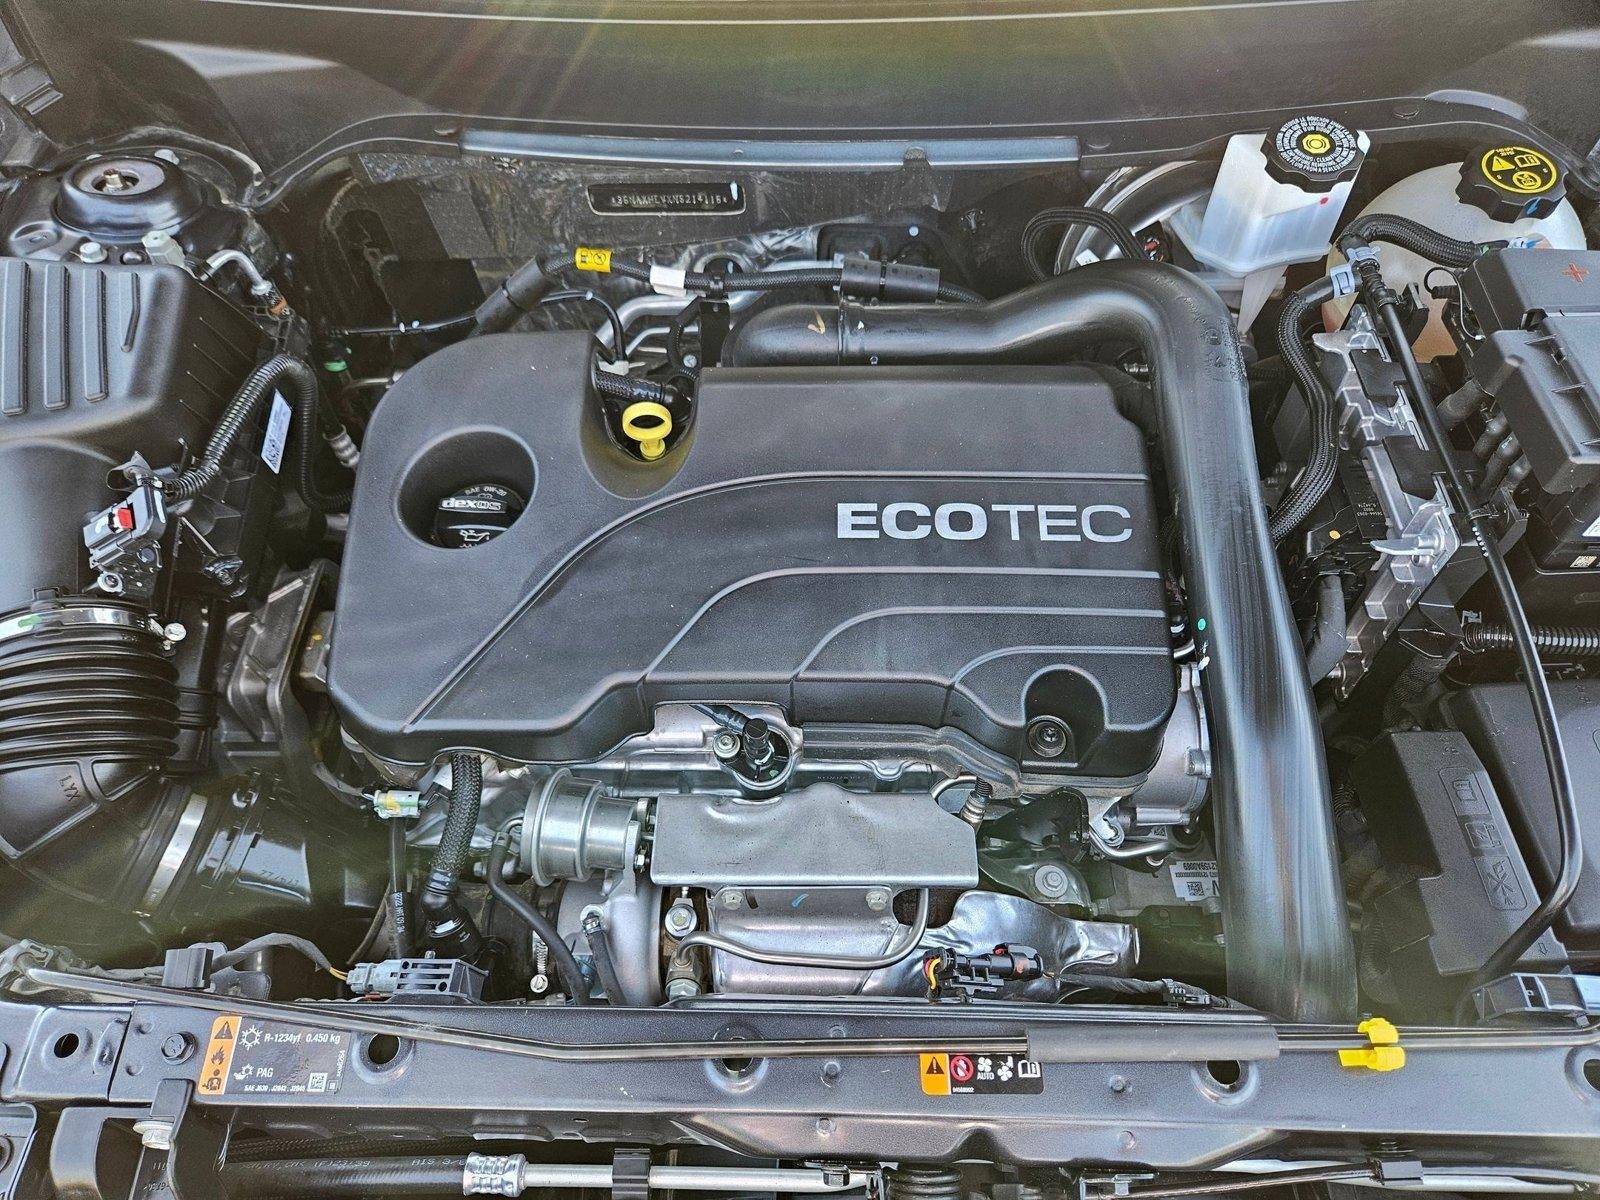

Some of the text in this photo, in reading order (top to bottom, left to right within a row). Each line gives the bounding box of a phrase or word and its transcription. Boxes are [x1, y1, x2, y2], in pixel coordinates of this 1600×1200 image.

[441, 497, 502, 511] dexos
[836, 502, 1133, 543] ECOTEC
[264, 1033, 341, 1045] R-1234yf 0.450 kg
[256, 1067, 274, 1078] PAG
[976, 1072, 995, 1081] AUTO
